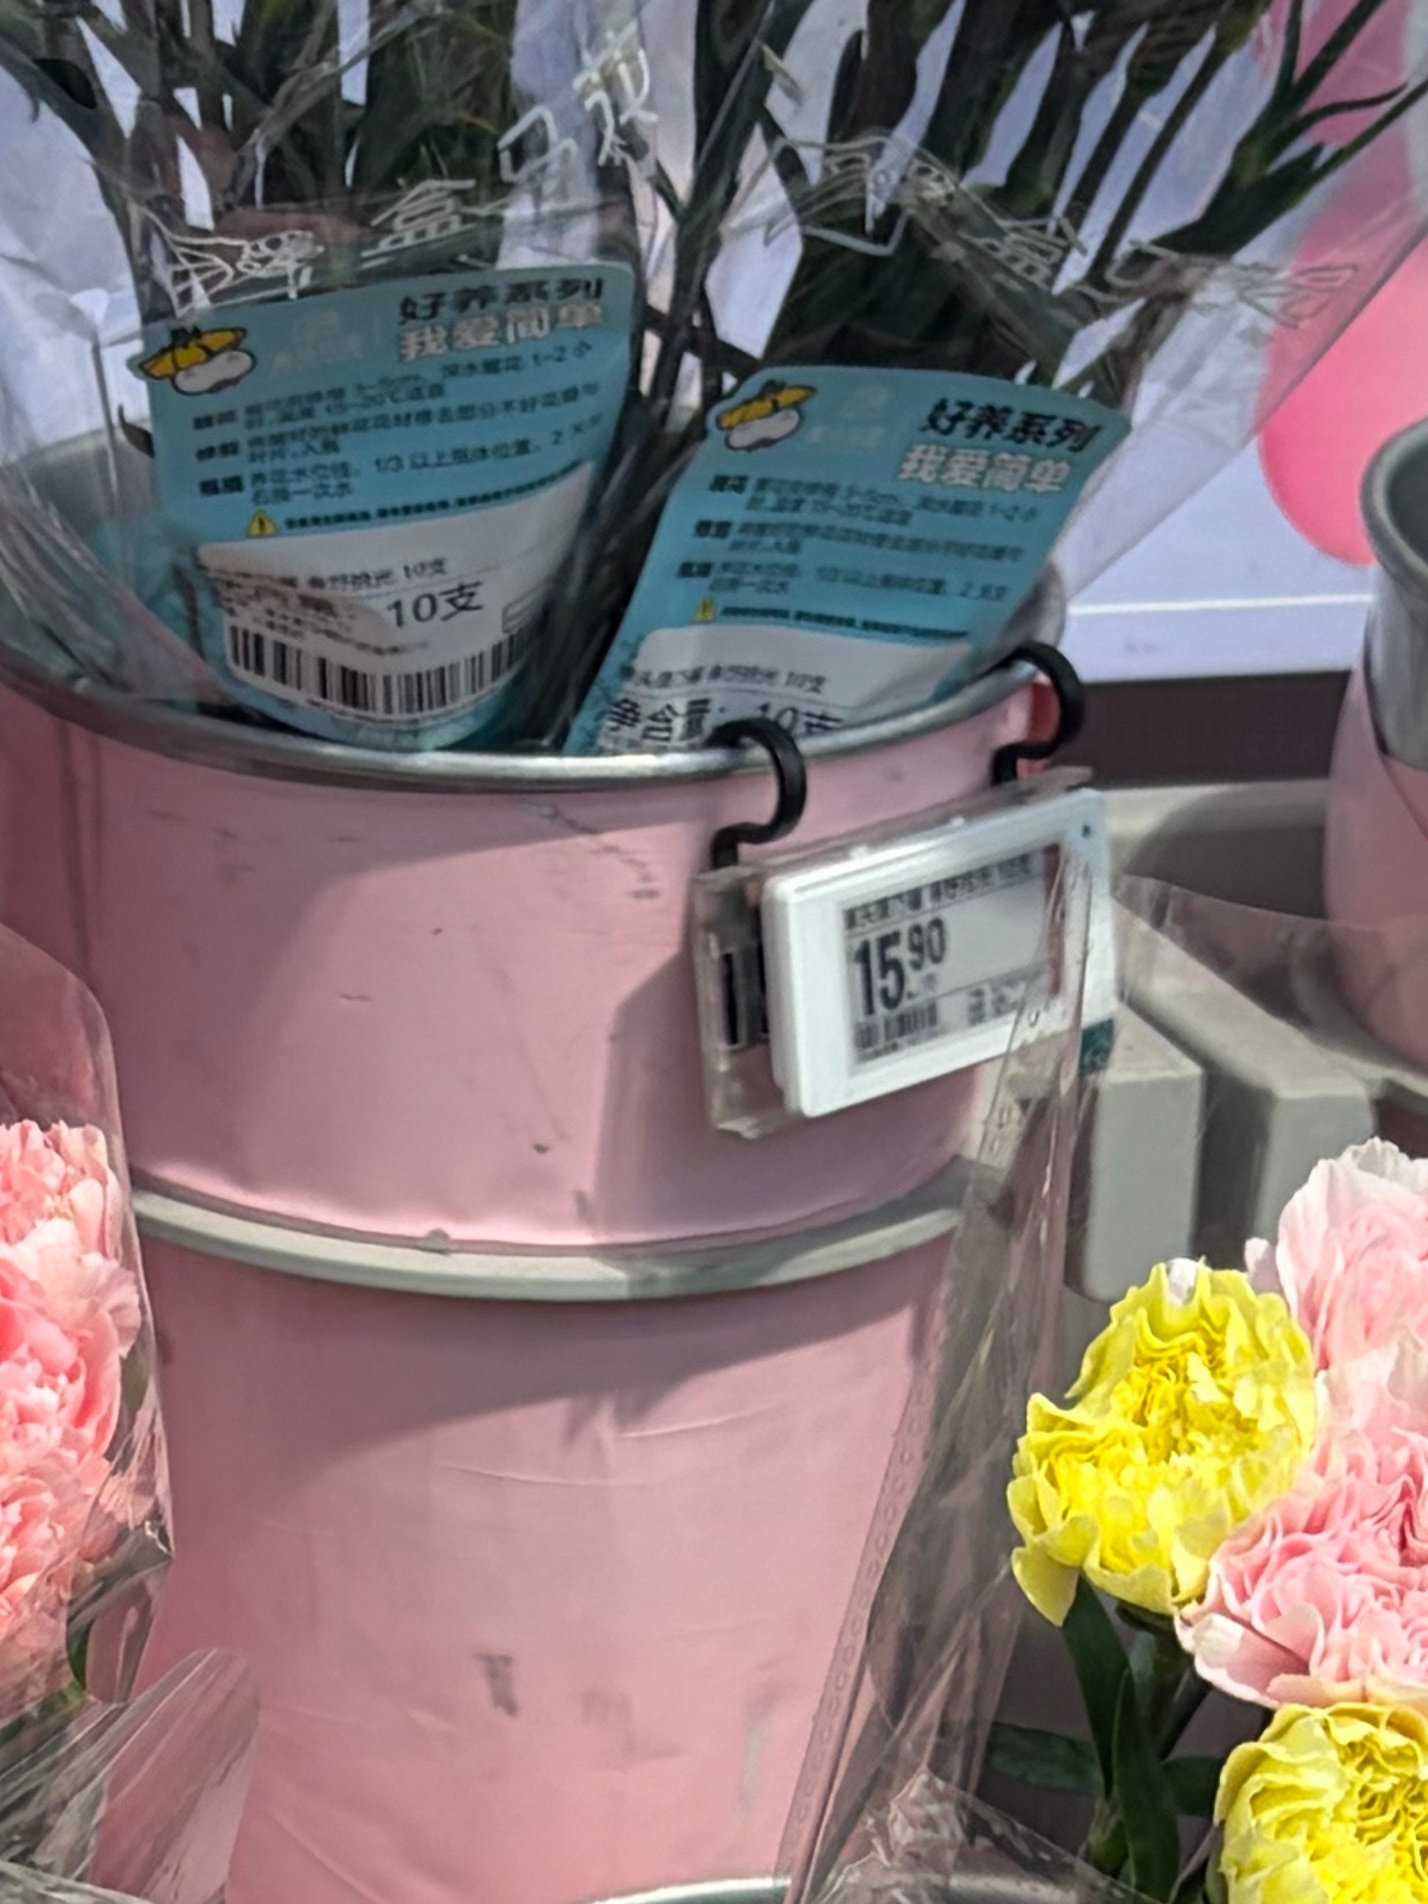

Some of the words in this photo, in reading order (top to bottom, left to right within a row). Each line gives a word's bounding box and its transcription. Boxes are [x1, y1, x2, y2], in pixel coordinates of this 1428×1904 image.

[397, 277, 605, 326] 好养系列
[397, 304, 605, 364] 我爱简单
[919, 396, 1102, 454] 好养系列
[897, 442, 1072, 494] 我爱简单
[386, 580, 485, 629] 10支
